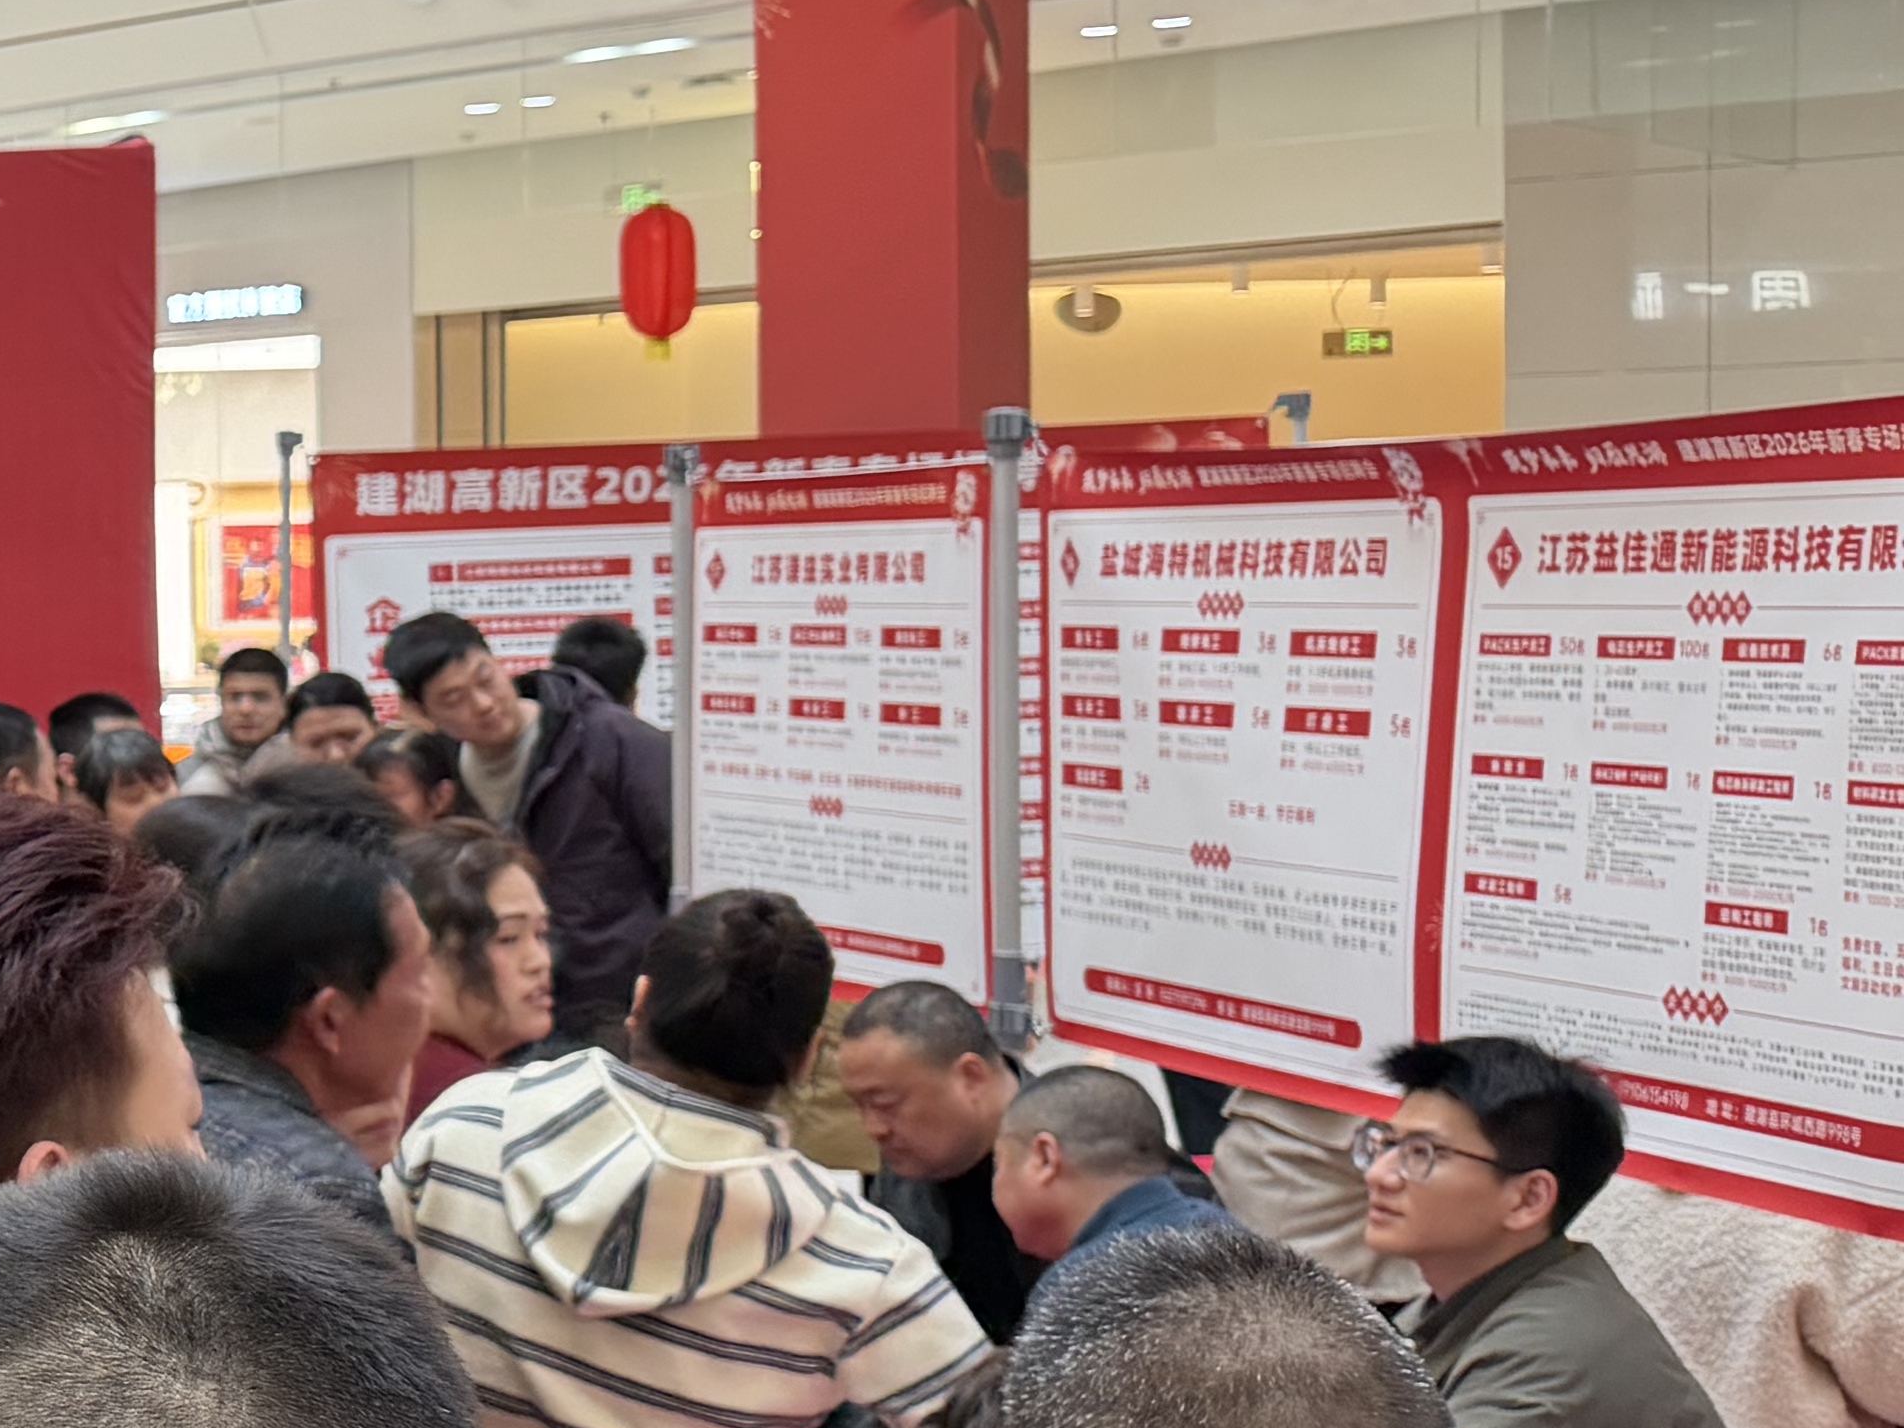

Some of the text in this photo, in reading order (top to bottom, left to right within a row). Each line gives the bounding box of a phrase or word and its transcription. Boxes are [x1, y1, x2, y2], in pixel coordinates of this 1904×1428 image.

[1537, 524, 1904, 574] 江苏益佳通新能源科技有限
